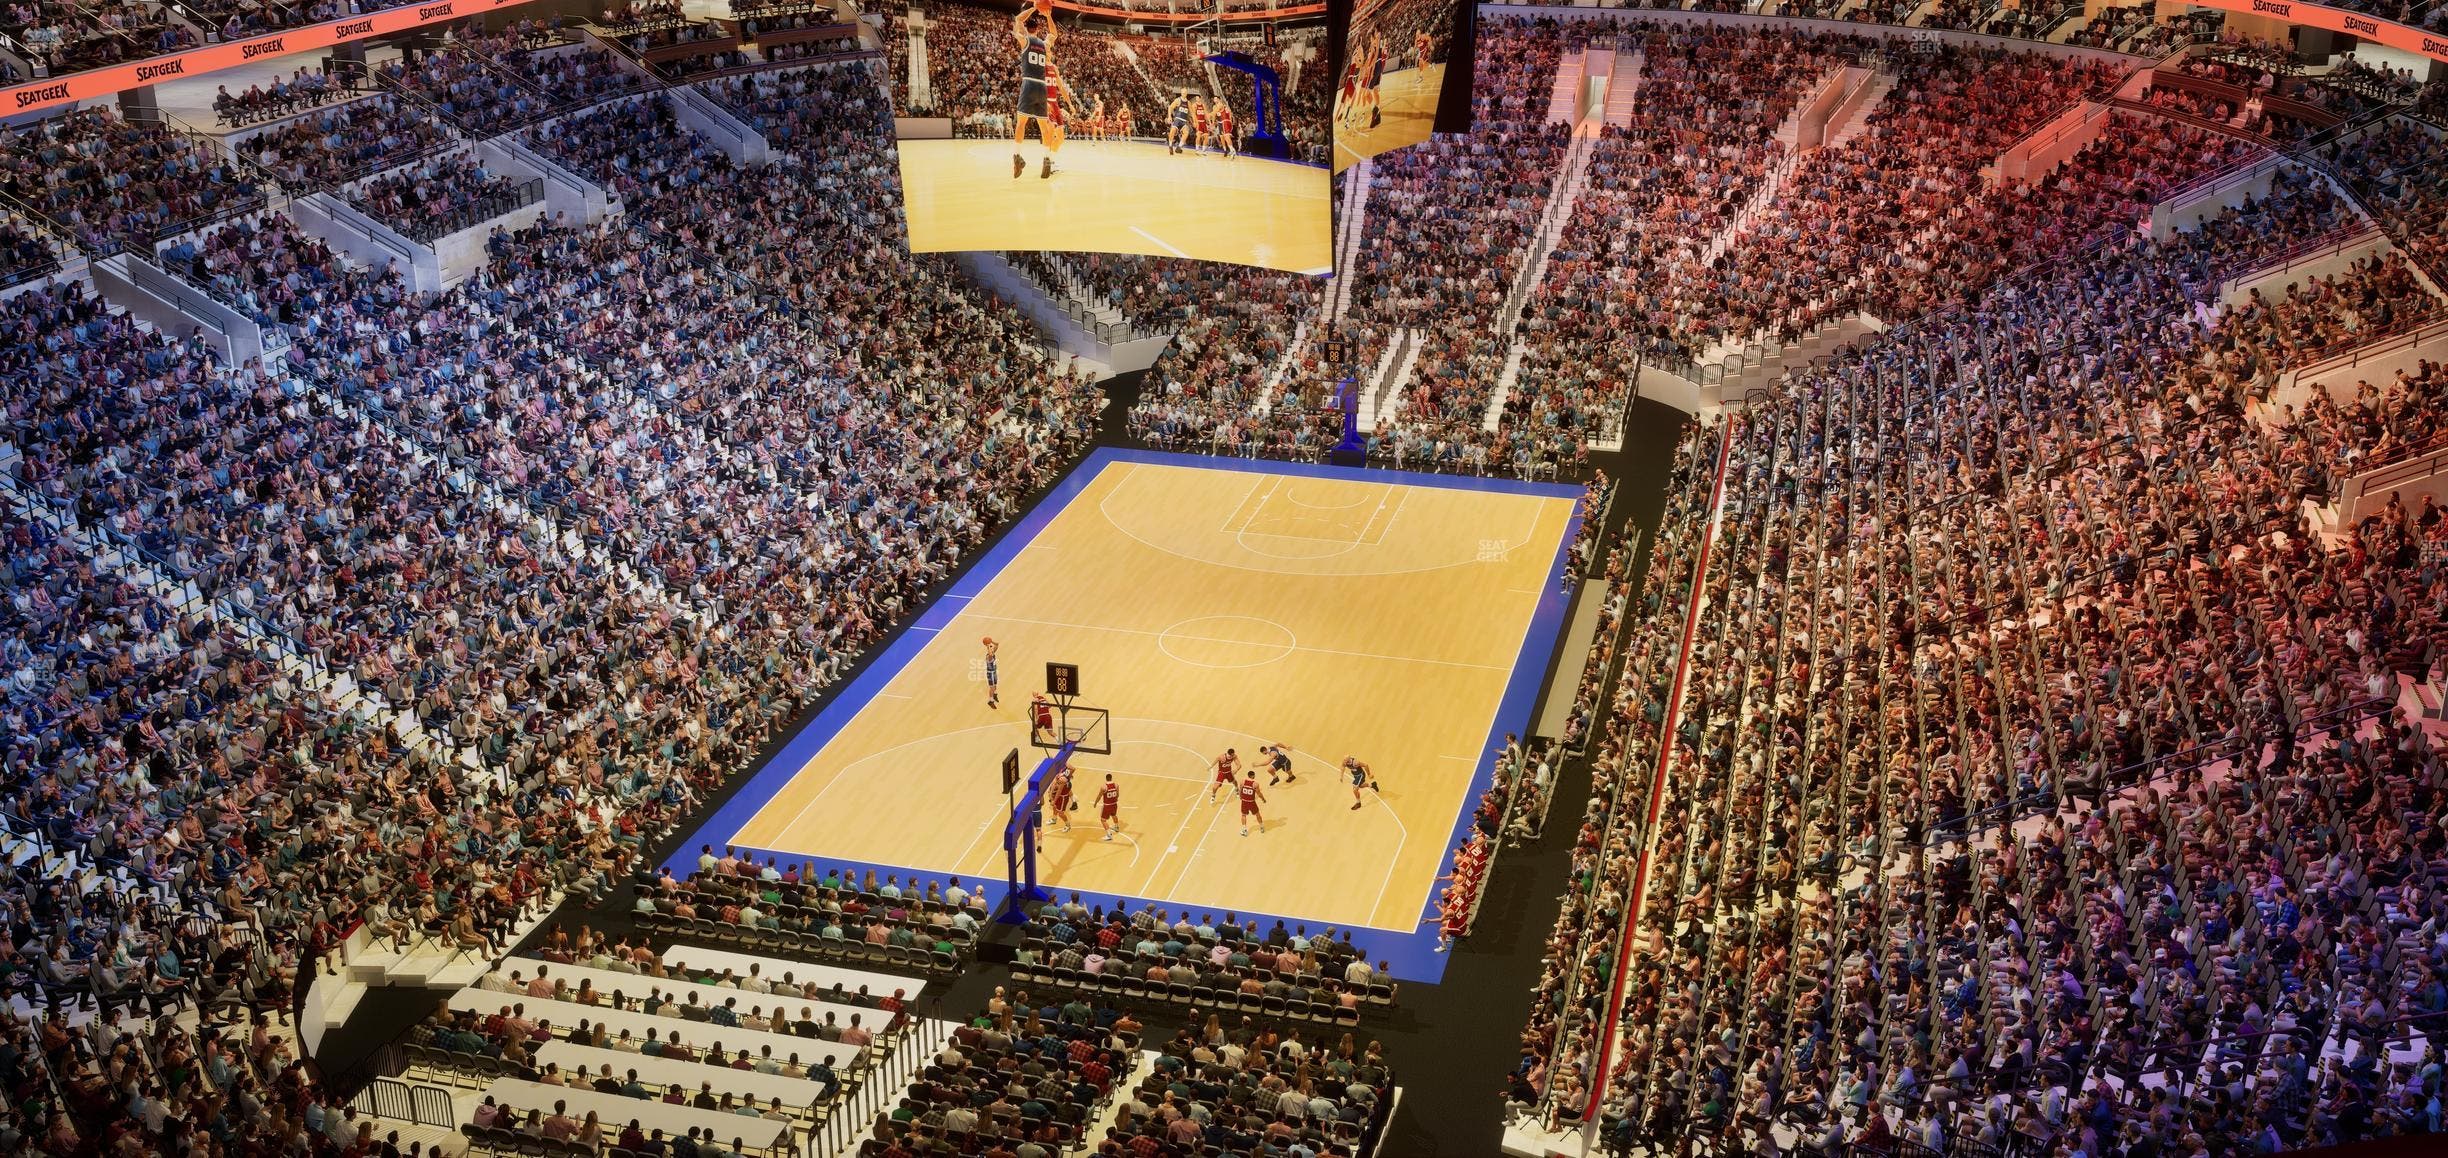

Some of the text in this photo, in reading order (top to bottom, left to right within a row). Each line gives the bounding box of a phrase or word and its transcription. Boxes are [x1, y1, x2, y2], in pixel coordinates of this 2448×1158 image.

[420, 5, 453, 21] SEATGEEK
[2252, 0, 2291, 18] SEATGEEK
[336, 19, 374, 39] SEATGEEK
[2344, 16, 2379, 37] SEATGEEK
[242, 38, 284, 59] SEATGEEK
[1028, 51, 1046, 67] 00
[136, 59, 184, 82] SEATGEEK
[16, 82, 71, 109] SEATGEEK
